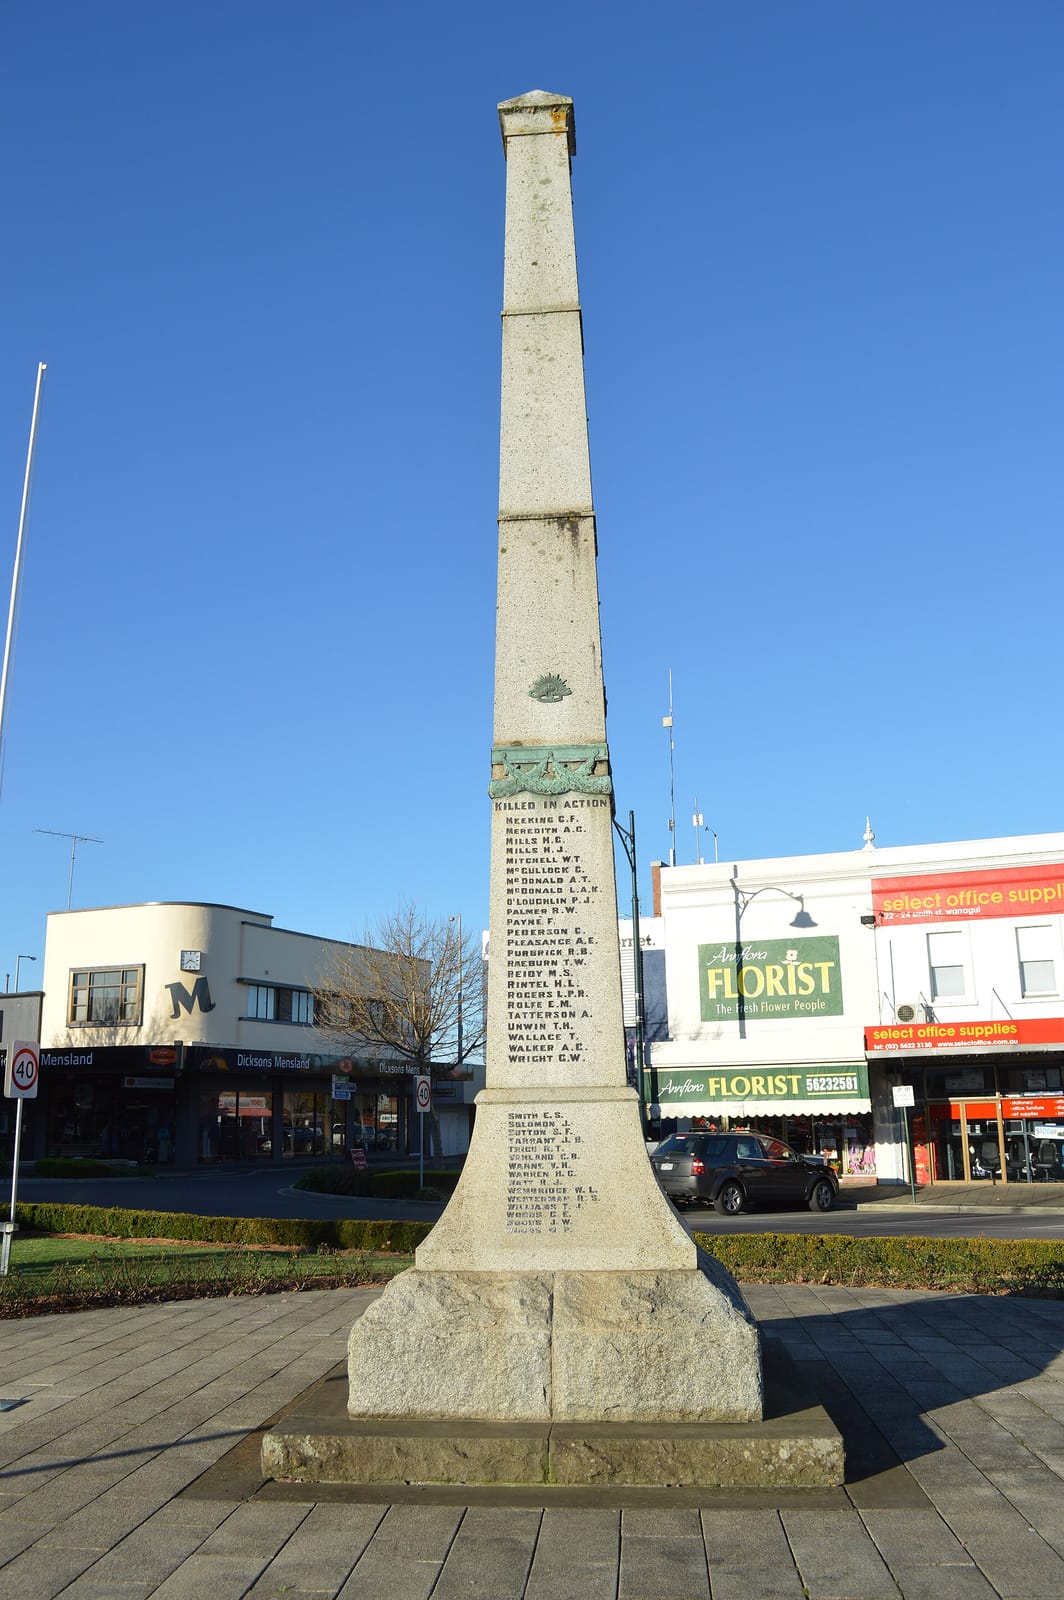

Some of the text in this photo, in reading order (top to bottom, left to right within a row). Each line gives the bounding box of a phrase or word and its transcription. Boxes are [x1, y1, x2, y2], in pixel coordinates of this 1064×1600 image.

[495, 799, 608, 811] KILLED IN ACTION
[883, 892, 940, 912] select
[947, 890, 1002, 906] office
[912, 910, 933, 918] smith
[946, 906, 980, 914] warragul
[707, 945, 768, 966] Annflora
[708, 962, 834, 999] FLORIST
[716, 1000, 826, 1014] The Fresh Flower People
[508, 1011, 576, 1019] TATTERSON
[874, 1024, 1017, 1040] select office supplies
[41, 1053, 93, 1066] Mensland
[237, 1054, 310, 1069] Dicksons Mensland
[508, 1055, 553, 1063] WRIGHT
[16, 1060, 34, 1078] 40
[658, 1076, 858, 1096] Annflora FLORIST 56232581
[420, 1088, 428, 1100] 40
